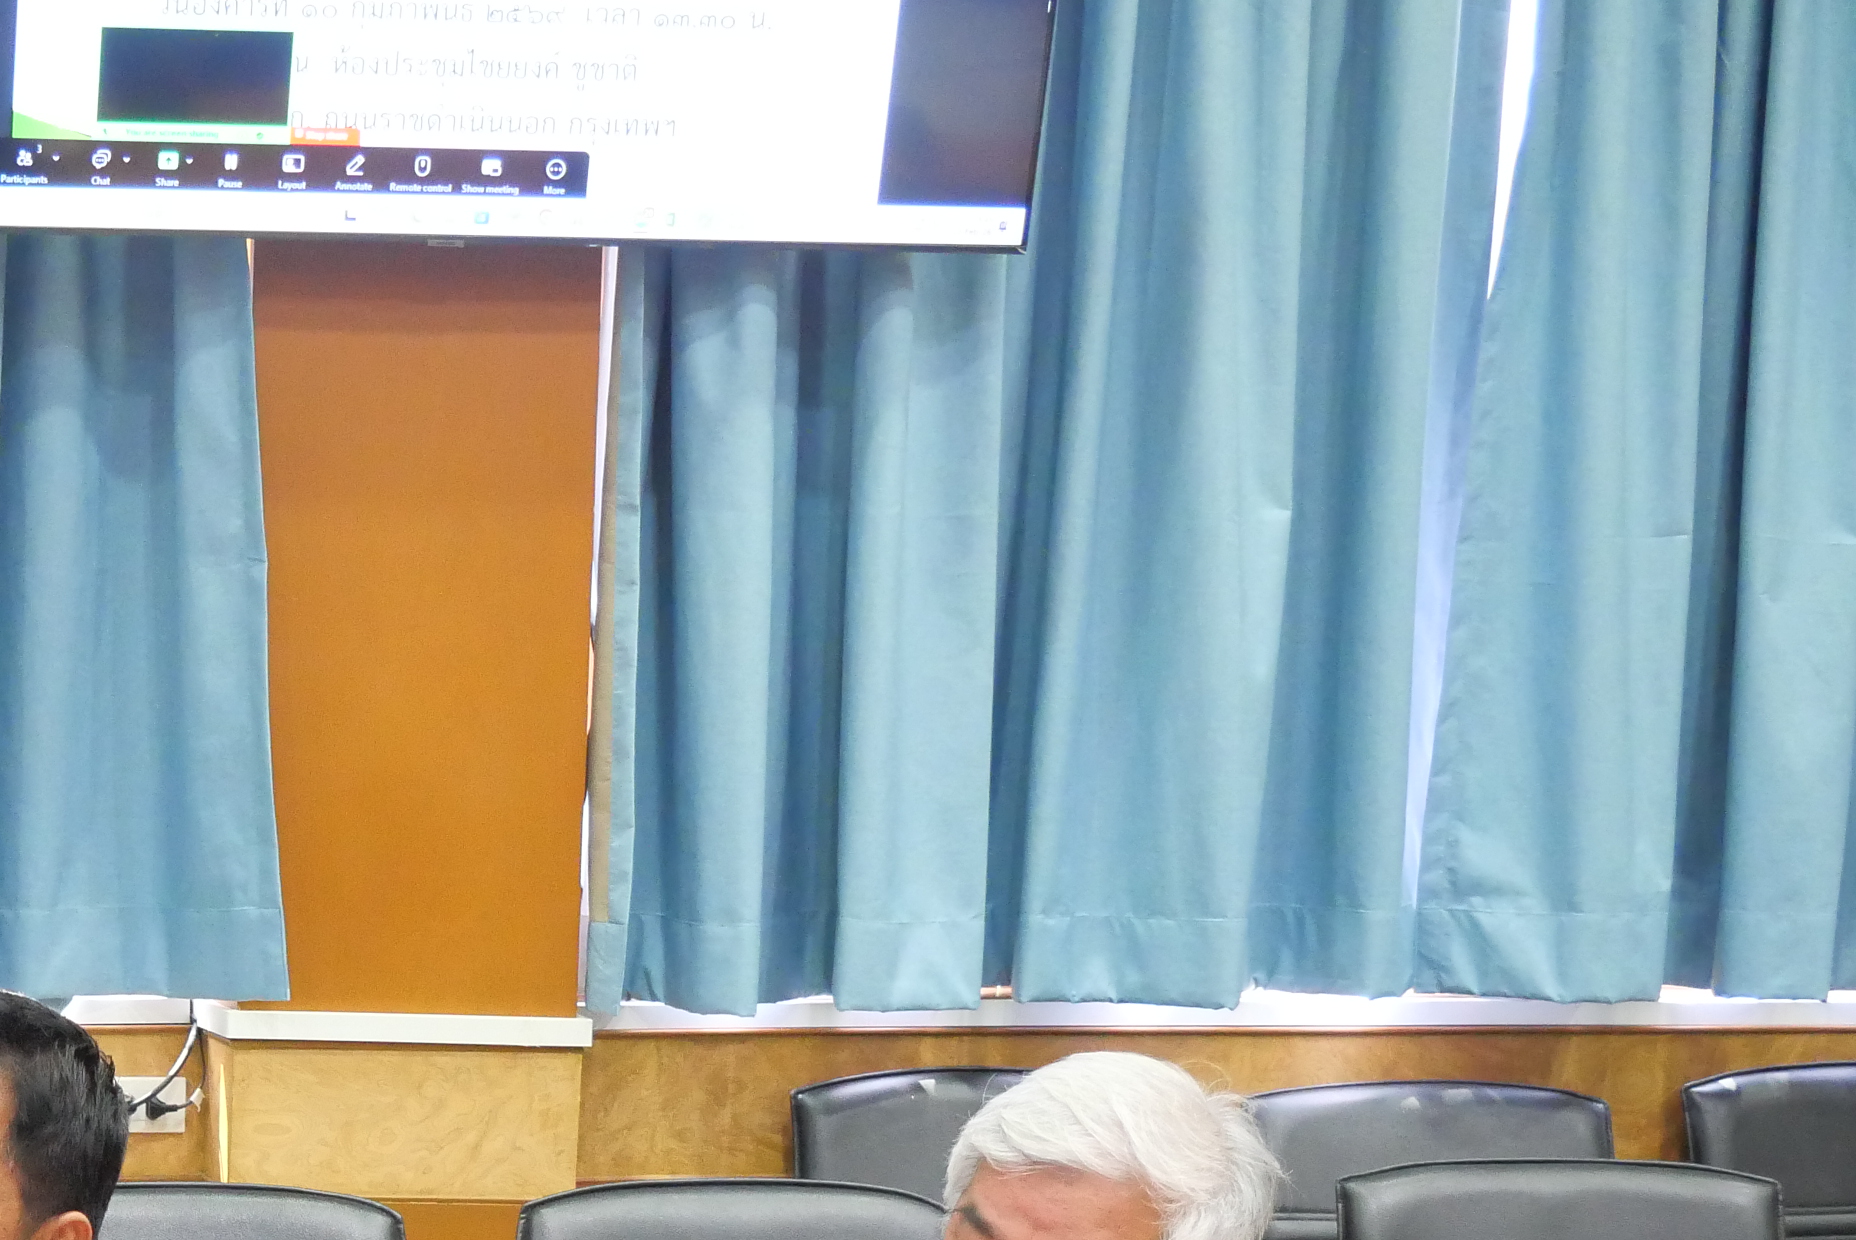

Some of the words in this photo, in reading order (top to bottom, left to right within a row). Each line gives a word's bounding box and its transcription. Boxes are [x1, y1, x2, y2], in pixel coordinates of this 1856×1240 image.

[586, 7, 641, 26] เวลา
[0, 174, 48, 185] Participants
[90, 176, 111, 186] Chat
[155, 177, 180, 188] Share
[217, 179, 243, 189] Pause
[278, 180, 306, 191] Layout
[334, 181, 373, 192] Annotate
[389, 182, 421, 193] Remote
[422, 183, 452, 194] control
[461, 184, 485, 194] Show
[486, 185, 520, 196] meeting
[543, 186, 566, 196] More
